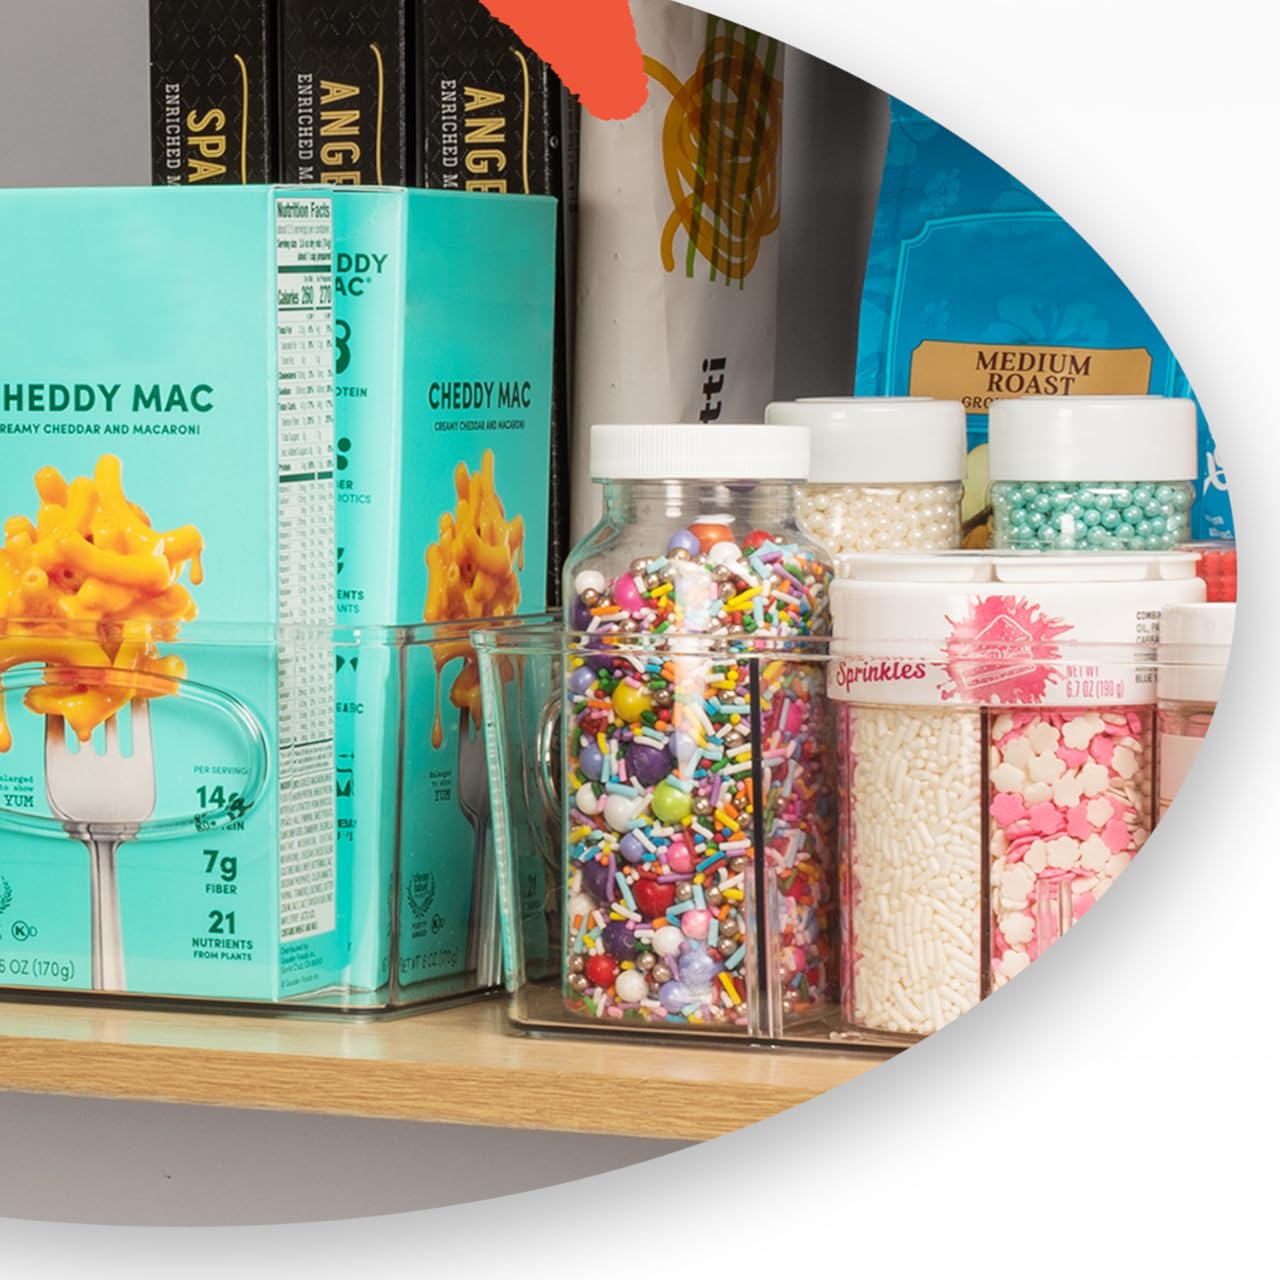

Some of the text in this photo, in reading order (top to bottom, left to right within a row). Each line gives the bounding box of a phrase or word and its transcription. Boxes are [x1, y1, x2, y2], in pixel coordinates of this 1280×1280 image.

[297, 72, 314, 162] ENRICHED
[441, 79, 458, 169] ENRICHED
[164, 82, 181, 178] ENRICHED
[187, 107, 226, 182] SPA
[276, 201, 330, 218] Nutrition Facts
[975, 351, 1093, 377] MEDIUM
[428, 380, 532, 410] CHEDDY MAC
[986, 372, 1076, 397] ROAST
[130, 383, 216, 413] MAC
[43, 423, 100, 435] CHEDDAR
[103, 423, 130, 435] AND
[132, 422, 201, 435] MACARONI
[434, 420, 485, 431] CREAMY CHEDDAR
[836, 660, 927, 694] Sprinkles
[1066, 665, 1084, 678] NET
[1066, 679, 1095, 698] 6.7 OZ
[193, 765, 249, 776] PER SERVING
[13, 785, 35, 793] show
[3, 794, 35, 809] YUM
[202, 849, 238, 883] 7g
[204, 883, 238, 895] FIBER
[207, 909, 237, 935] 21
[191, 937, 254, 951] NUTRIENTS
[193, 950, 253, 961] FROM PLANTS
[9, 959, 30, 976] OZ
[33, 958, 76, 982] (170g)
